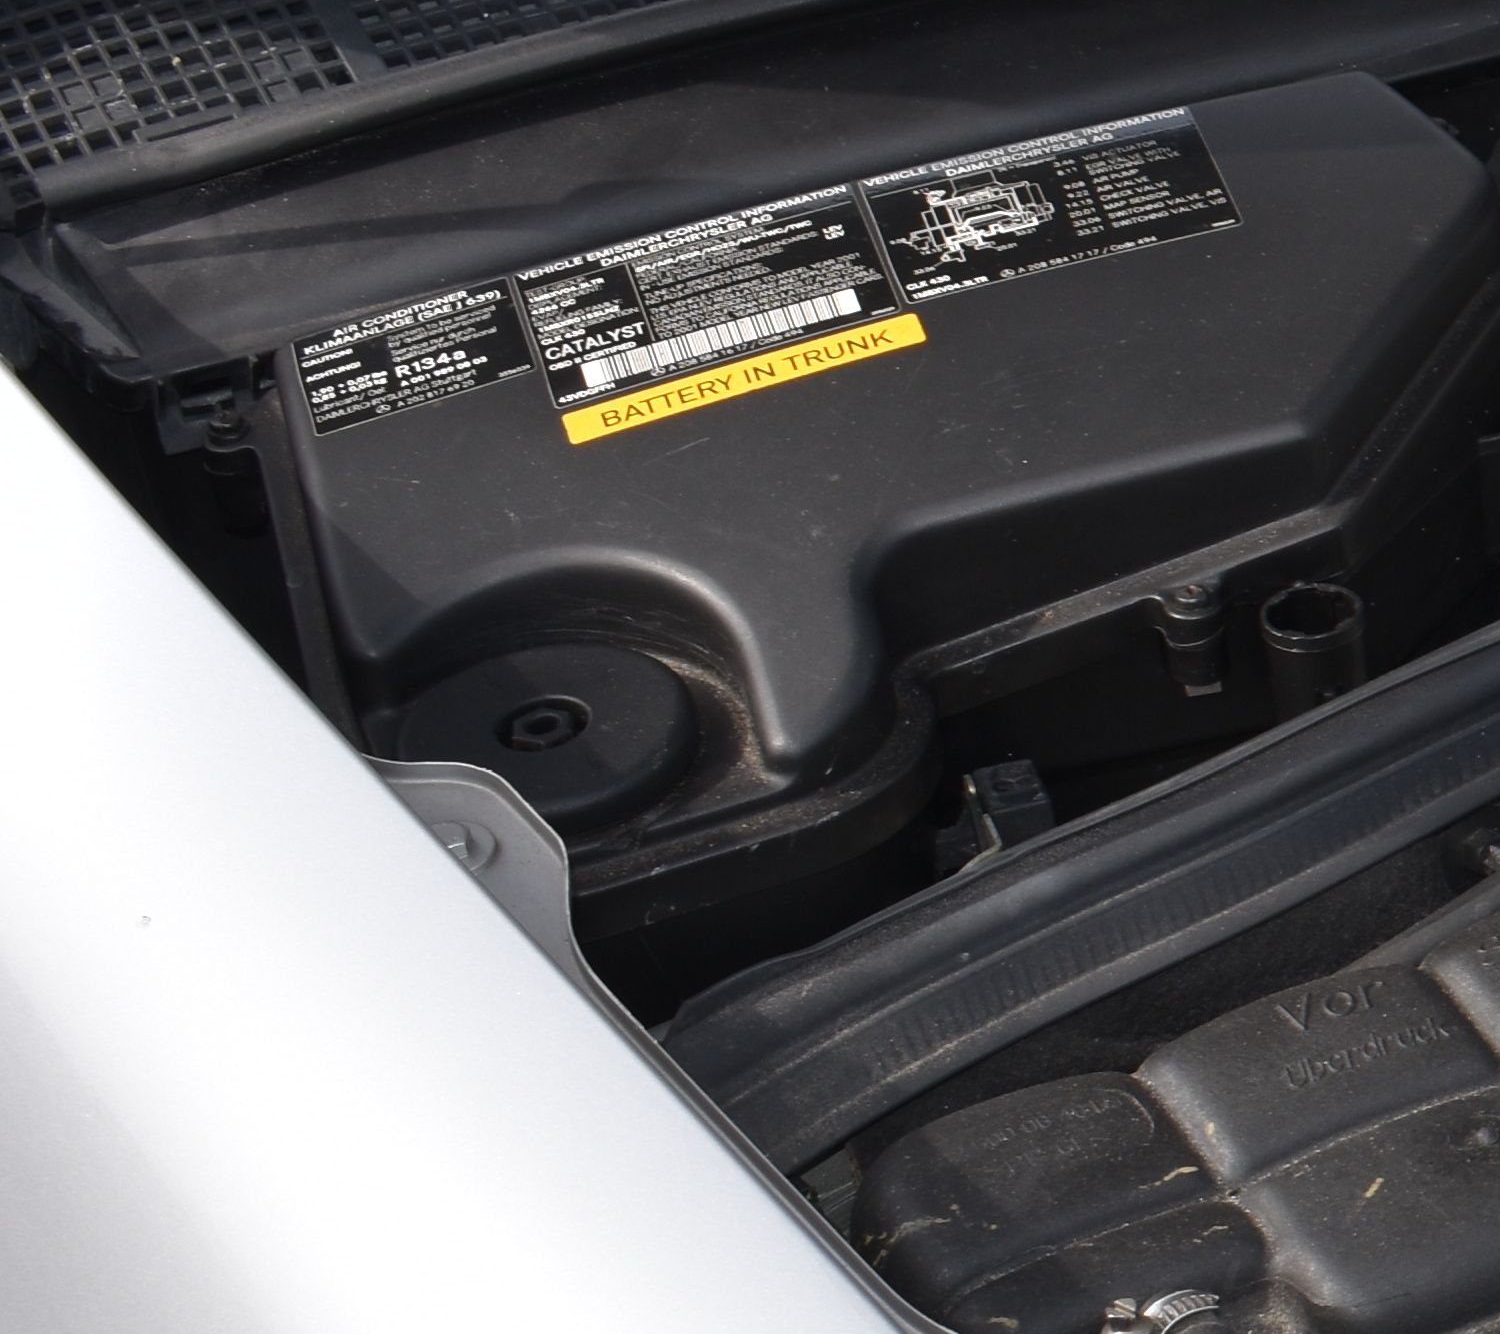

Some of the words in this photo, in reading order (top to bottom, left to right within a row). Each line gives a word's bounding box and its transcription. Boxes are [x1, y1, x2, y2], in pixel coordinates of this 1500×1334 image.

[863, 167, 927, 186] VEHICLE
[930, 148, 1004, 170] EMISSION
[1005, 132, 1078, 153] CONTROL
[1082, 109, 1184, 135] INFORMATION
[1091, 132, 1113, 143] AG
[518, 257, 582, 280] VEHICLE
[586, 236, 657, 260] EMISSION
[659, 215, 738, 240] CONTROL
[740, 185, 846, 218] INFORMATION
[600, 221, 746, 265] DAIMLERCHRYSLER
[750, 213, 773, 225] AG
[303, 316, 414, 355] KLIMAANLAGE
[332, 323, 358, 337] AIR
[361, 291, 468, 326] CONDITIONER
[394, 347, 465, 377] R134a
[543, 322, 647, 359] CATALYST
[598, 375, 736, 426] BATTERY
[741, 363, 777, 384] IN
[782, 330, 893, 371] TRUNK
